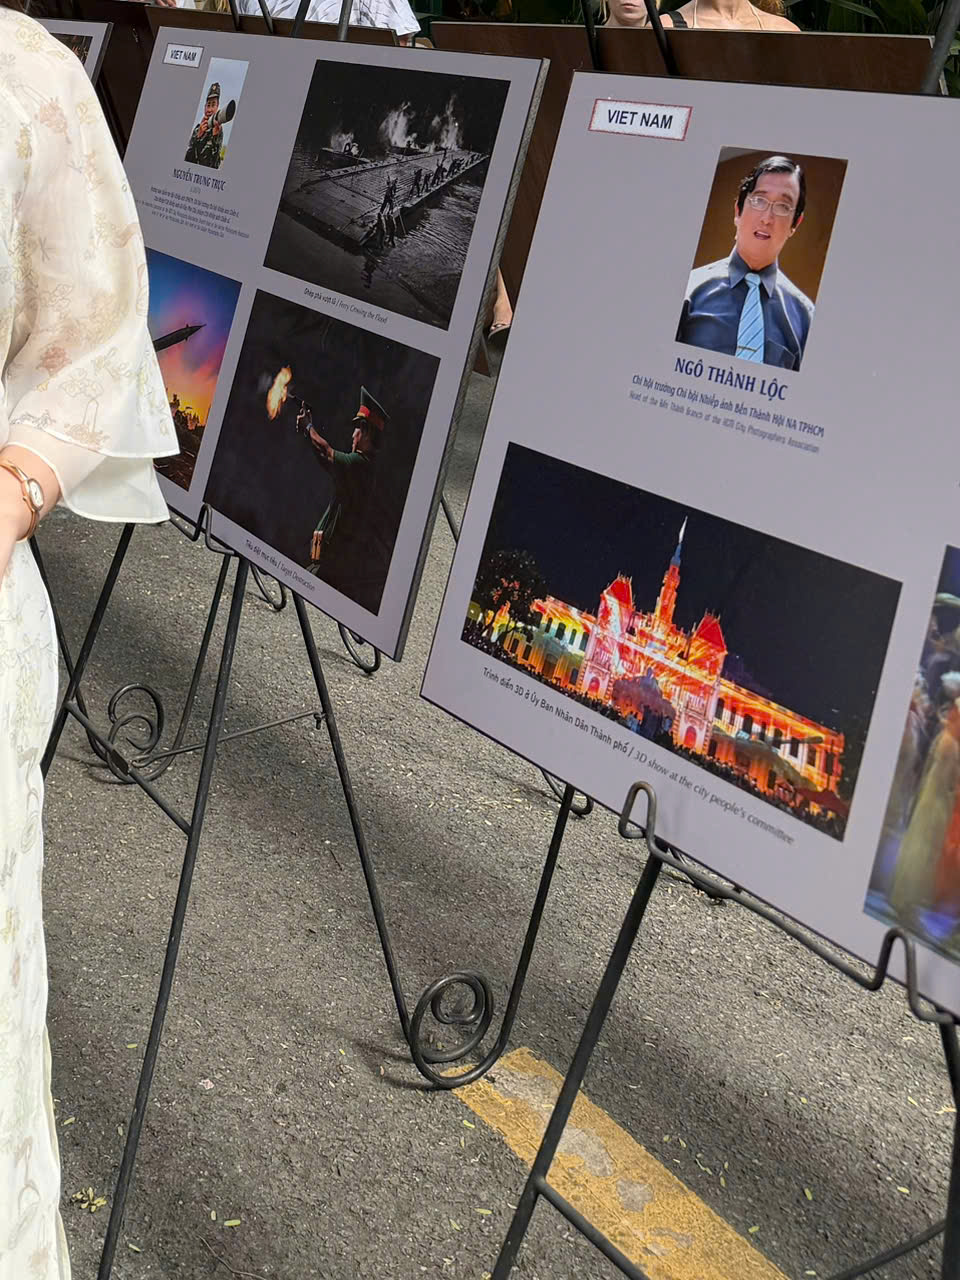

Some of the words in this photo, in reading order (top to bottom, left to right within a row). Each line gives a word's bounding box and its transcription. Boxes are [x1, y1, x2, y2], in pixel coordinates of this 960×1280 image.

[608, 109, 638, 125] VIET
[640, 112, 673, 129] NAM
[674, 358, 704, 378] NGÔ
[708, 366, 756, 392] THÀNH
[760, 378, 788, 401] LỘC
[514, 684, 525, 696] 3D
[540, 698, 555, 713] Ban
[555, 706, 574, 724] Nhân
[574, 716, 589, 732] Dân
[590, 725, 612, 745] Thành
[612, 737, 629, 754] phố
[634, 750, 648, 764] 3D
[648, 758, 670, 777] show
[669, 771, 678, 782] at
[678, 774, 693, 789] the
[693, 783, 710, 799] city
